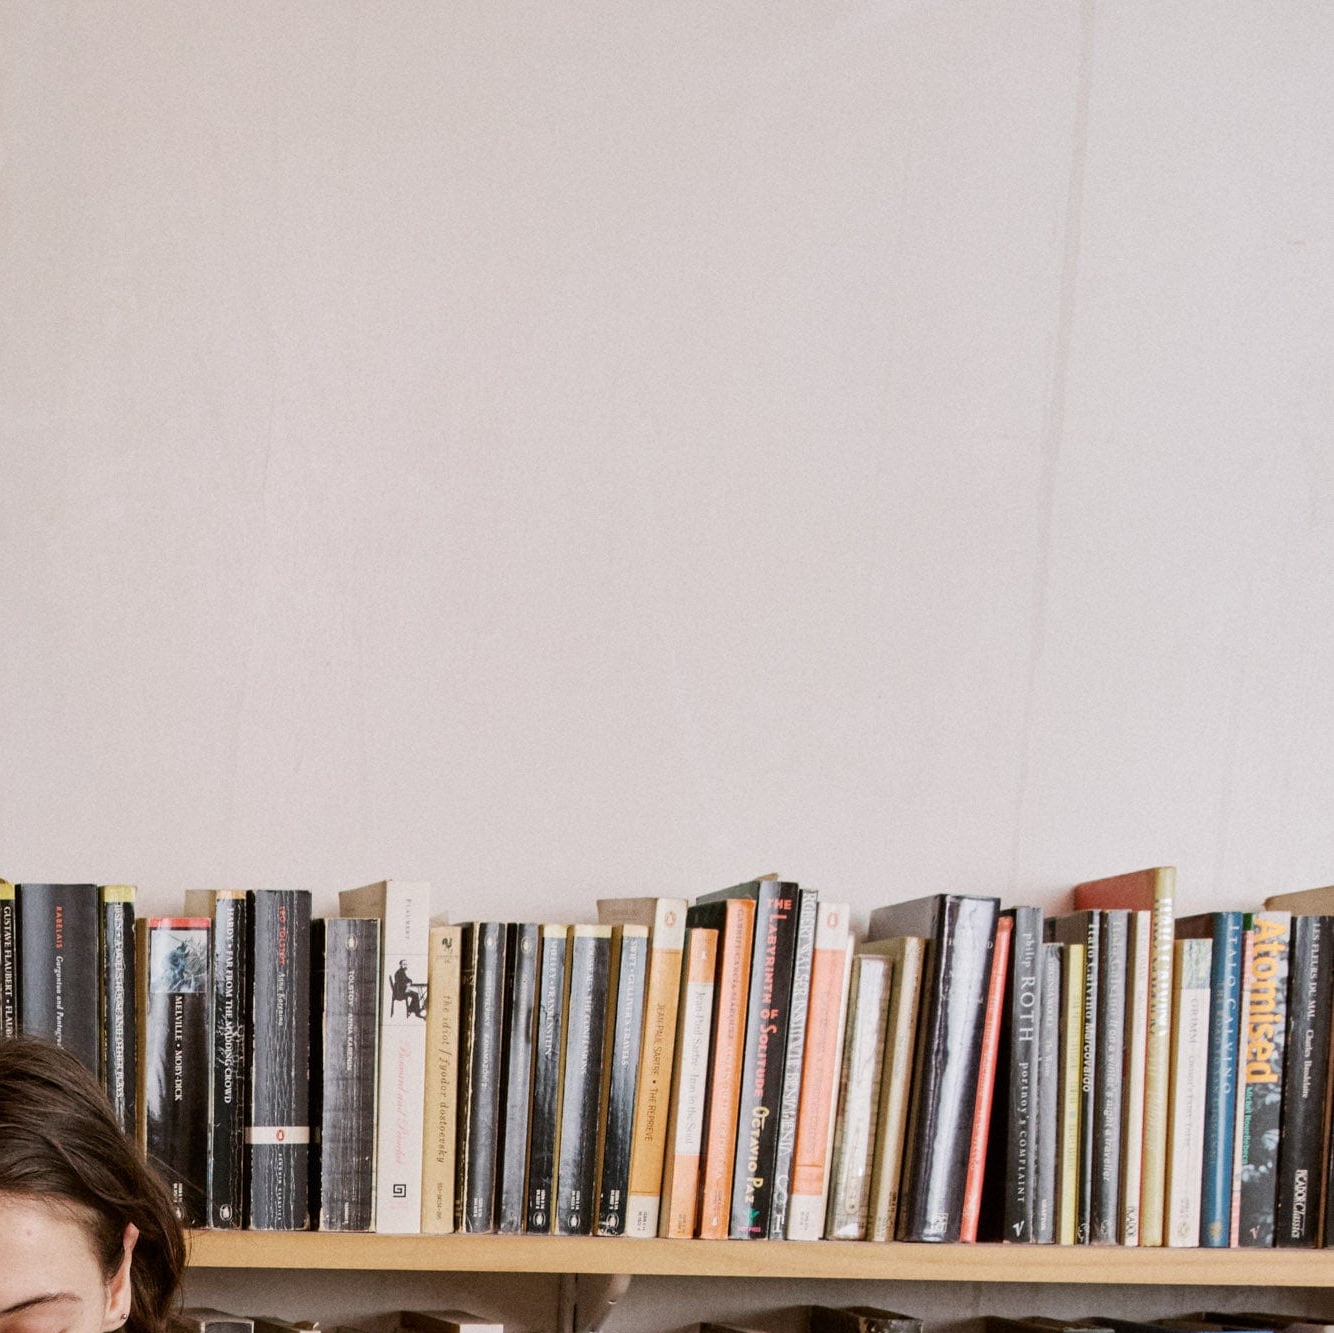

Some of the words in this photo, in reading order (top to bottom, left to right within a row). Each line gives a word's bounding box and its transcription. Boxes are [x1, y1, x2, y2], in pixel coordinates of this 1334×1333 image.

[1019, 933, 1035, 968] philip
[174, 996, 183, 1041] MELVILLE
[1018, 976, 1035, 1042] ROTH
[1245, 916, 1287, 1084] Atomised
[174, 1050, 183, 1101] MOBY-DICK
[1018, 1062, 1031, 1125] portnoy's
[1017, 1130, 1027, 1203] COMPLAINT
